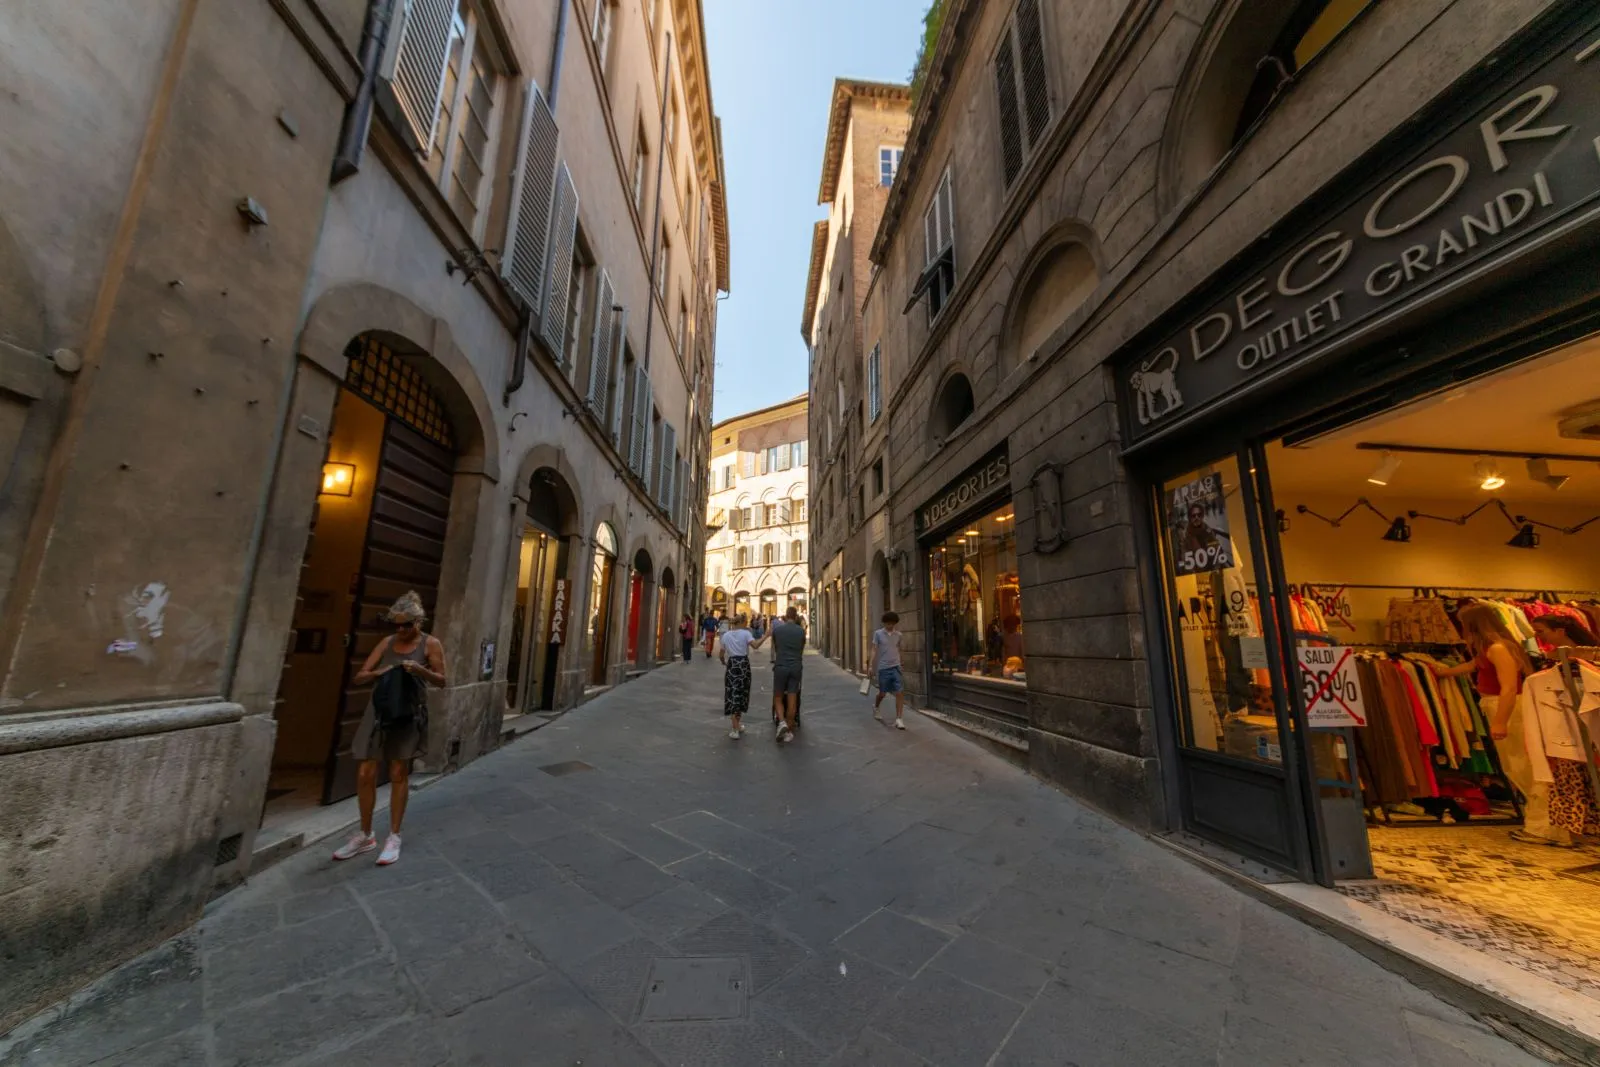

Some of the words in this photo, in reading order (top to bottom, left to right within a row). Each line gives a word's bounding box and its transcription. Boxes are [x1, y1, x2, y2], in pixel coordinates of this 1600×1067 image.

[1237, 289, 1346, 371] OUTLET
[1365, 171, 1554, 298] GRANDI
[931, 456, 1008, 521] DEGORTES
[1178, 545, 1228, 570] -50%
[550, 579, 565, 644] BARAKA
[1305, 649, 1336, 665] SALDI
[1302, 670, 1357, 702] 50%
